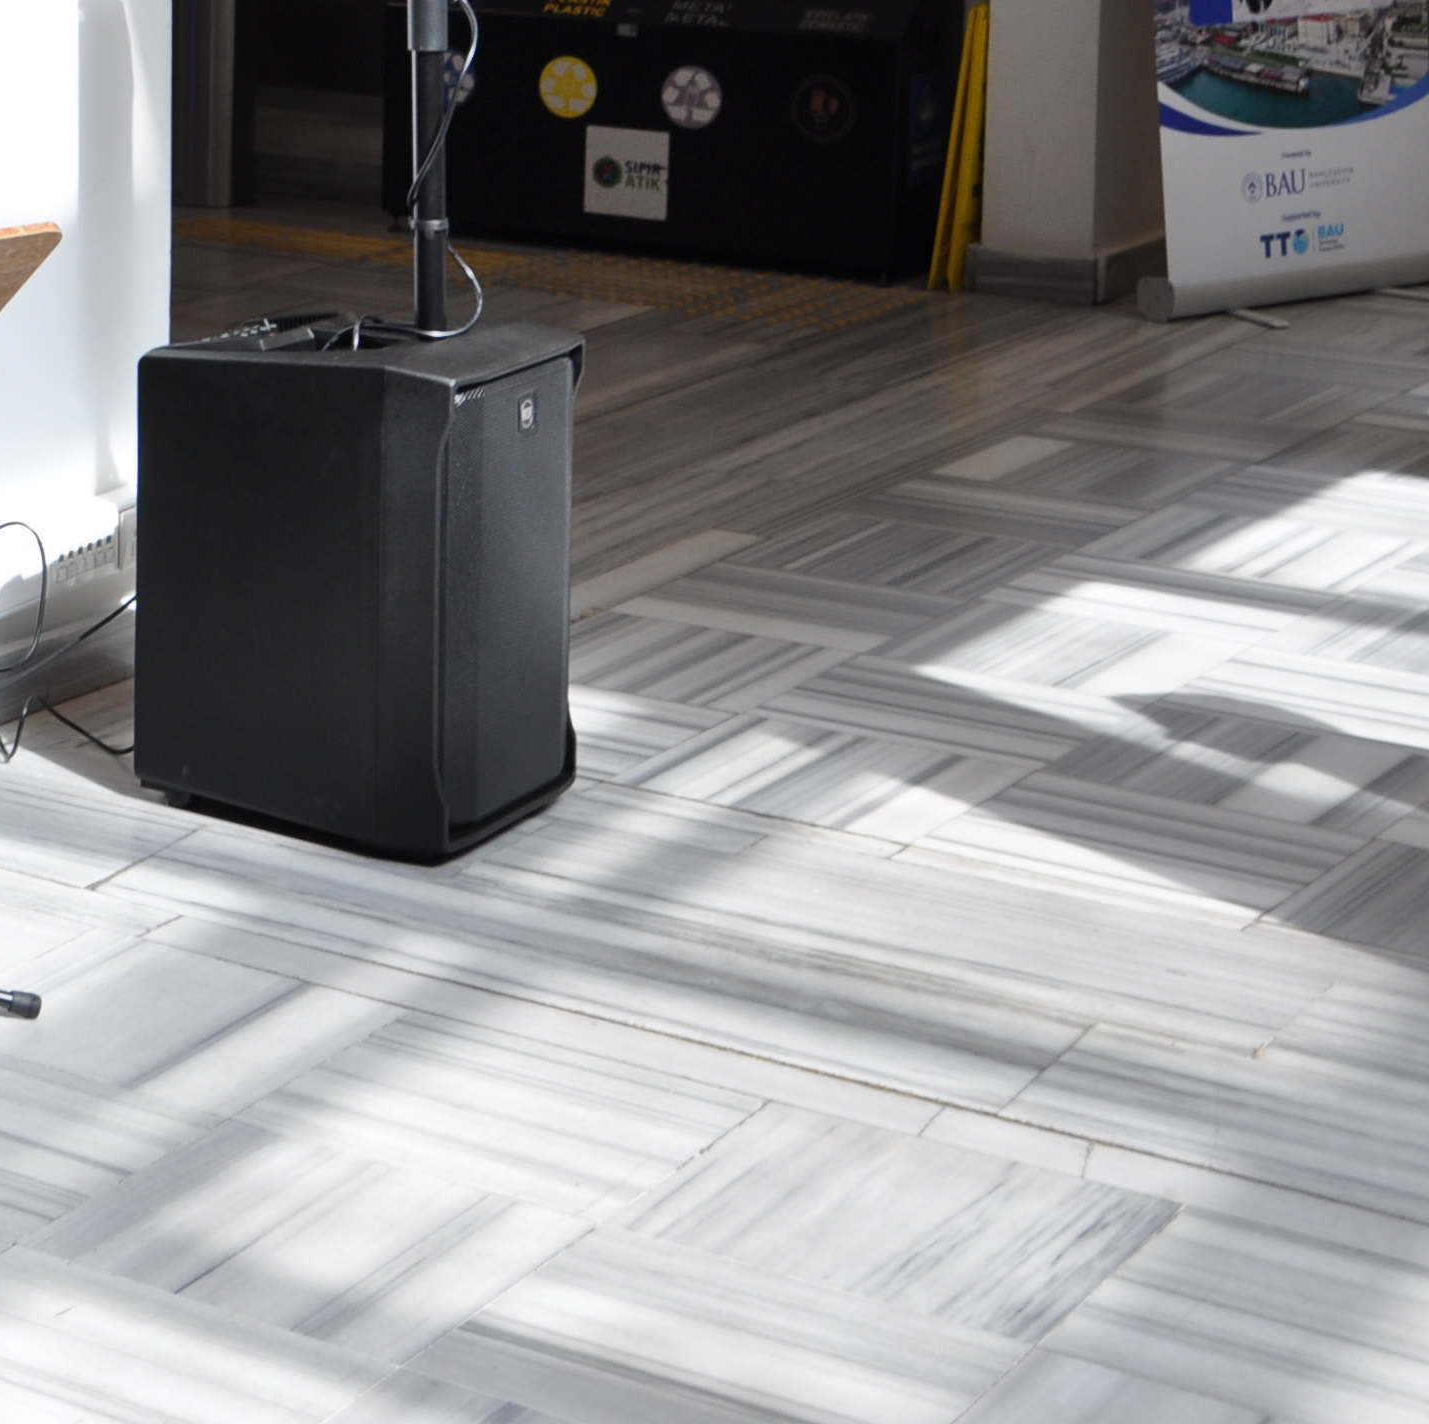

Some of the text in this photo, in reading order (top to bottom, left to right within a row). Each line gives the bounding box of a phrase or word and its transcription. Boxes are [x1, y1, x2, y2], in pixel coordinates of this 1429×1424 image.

[543, 3, 606, 17] PLASTIC
[625, 176, 661, 191] ATIK
[1265, 168, 1305, 197] BAU
